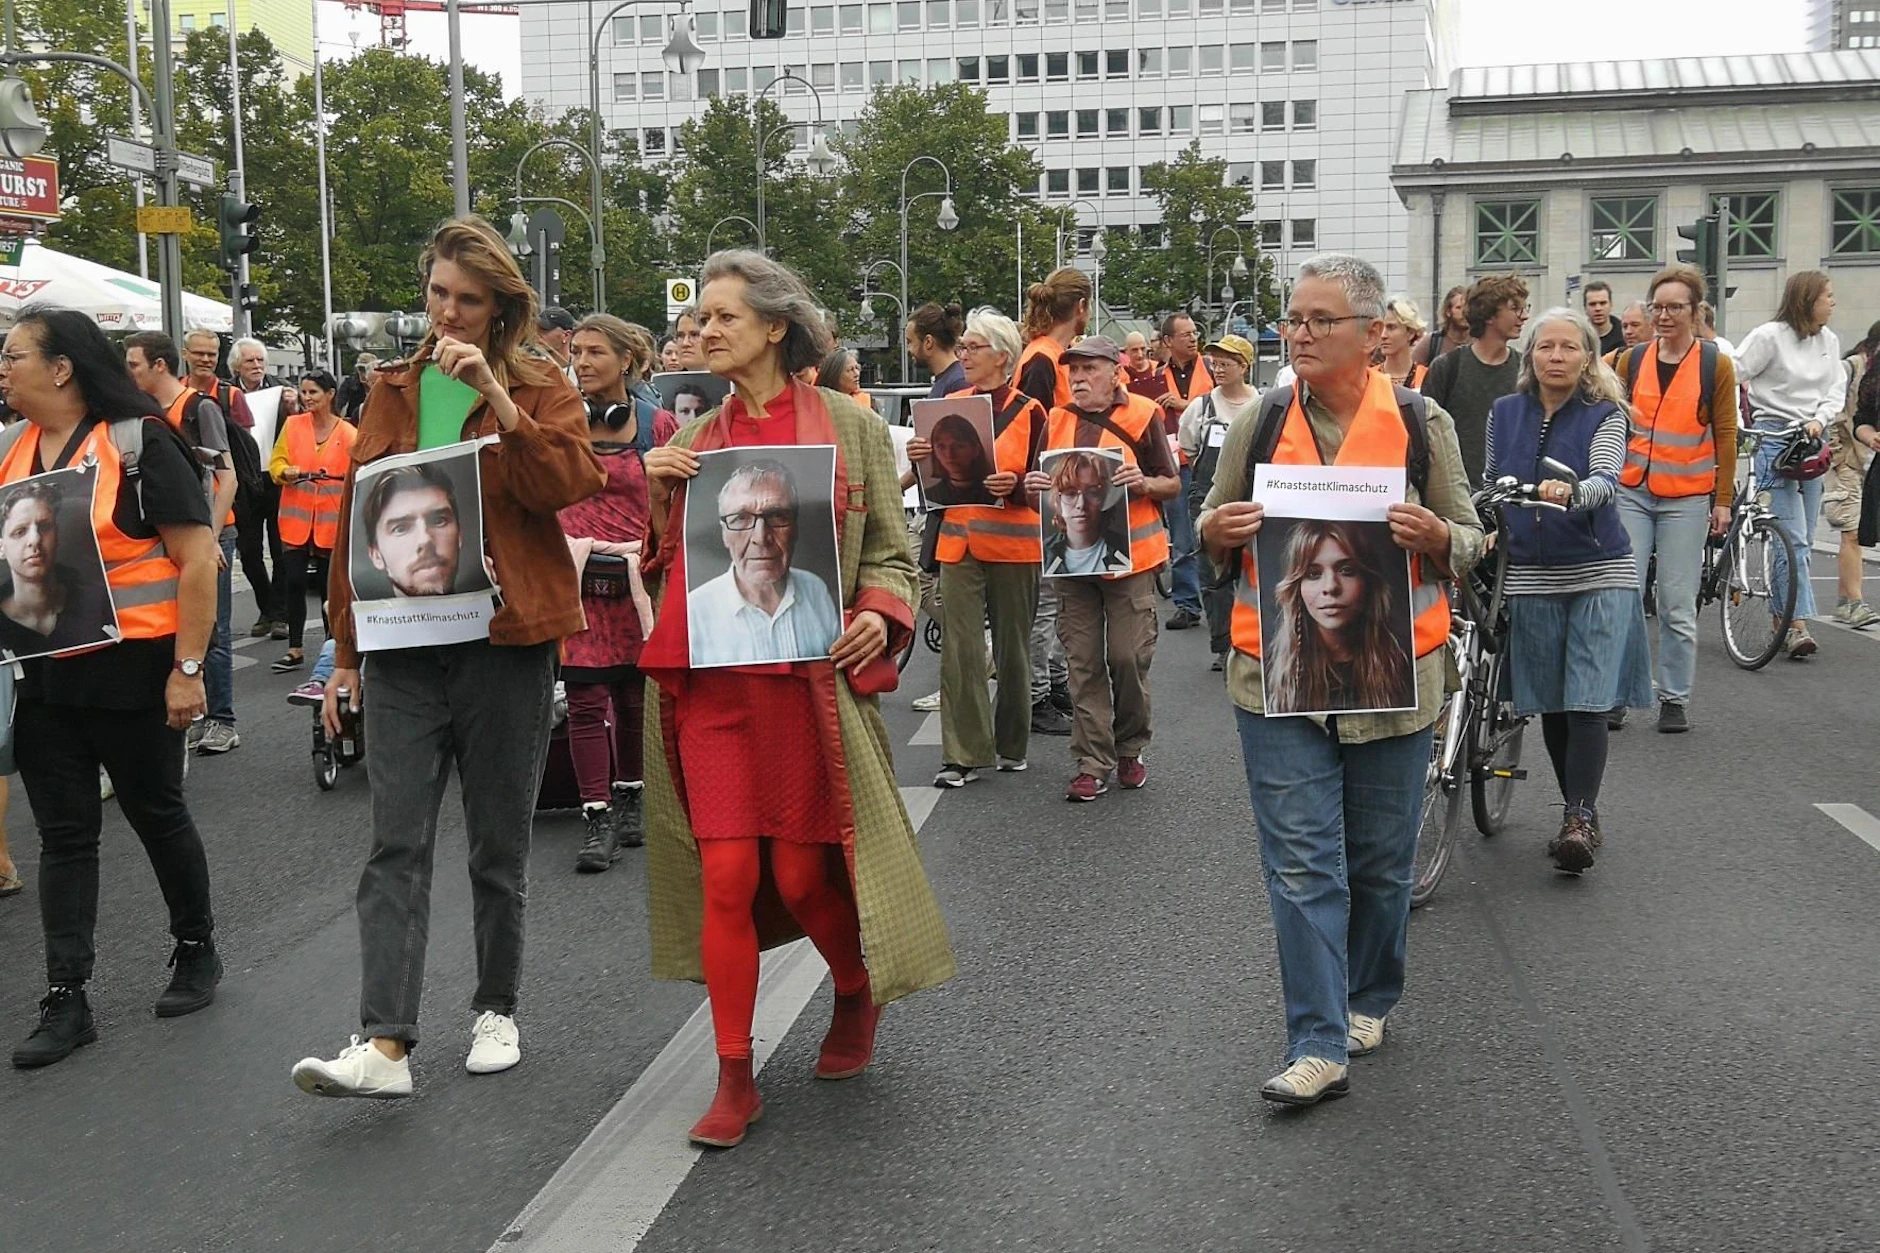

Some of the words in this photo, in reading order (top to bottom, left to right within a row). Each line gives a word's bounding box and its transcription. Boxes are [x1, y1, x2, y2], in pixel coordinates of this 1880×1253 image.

[1, 173, 47, 198] URST
[1266, 479, 1389, 494] #KnaststattKlimaschutz
[366, 610, 480, 625] #KnaststattKlimaschutz
